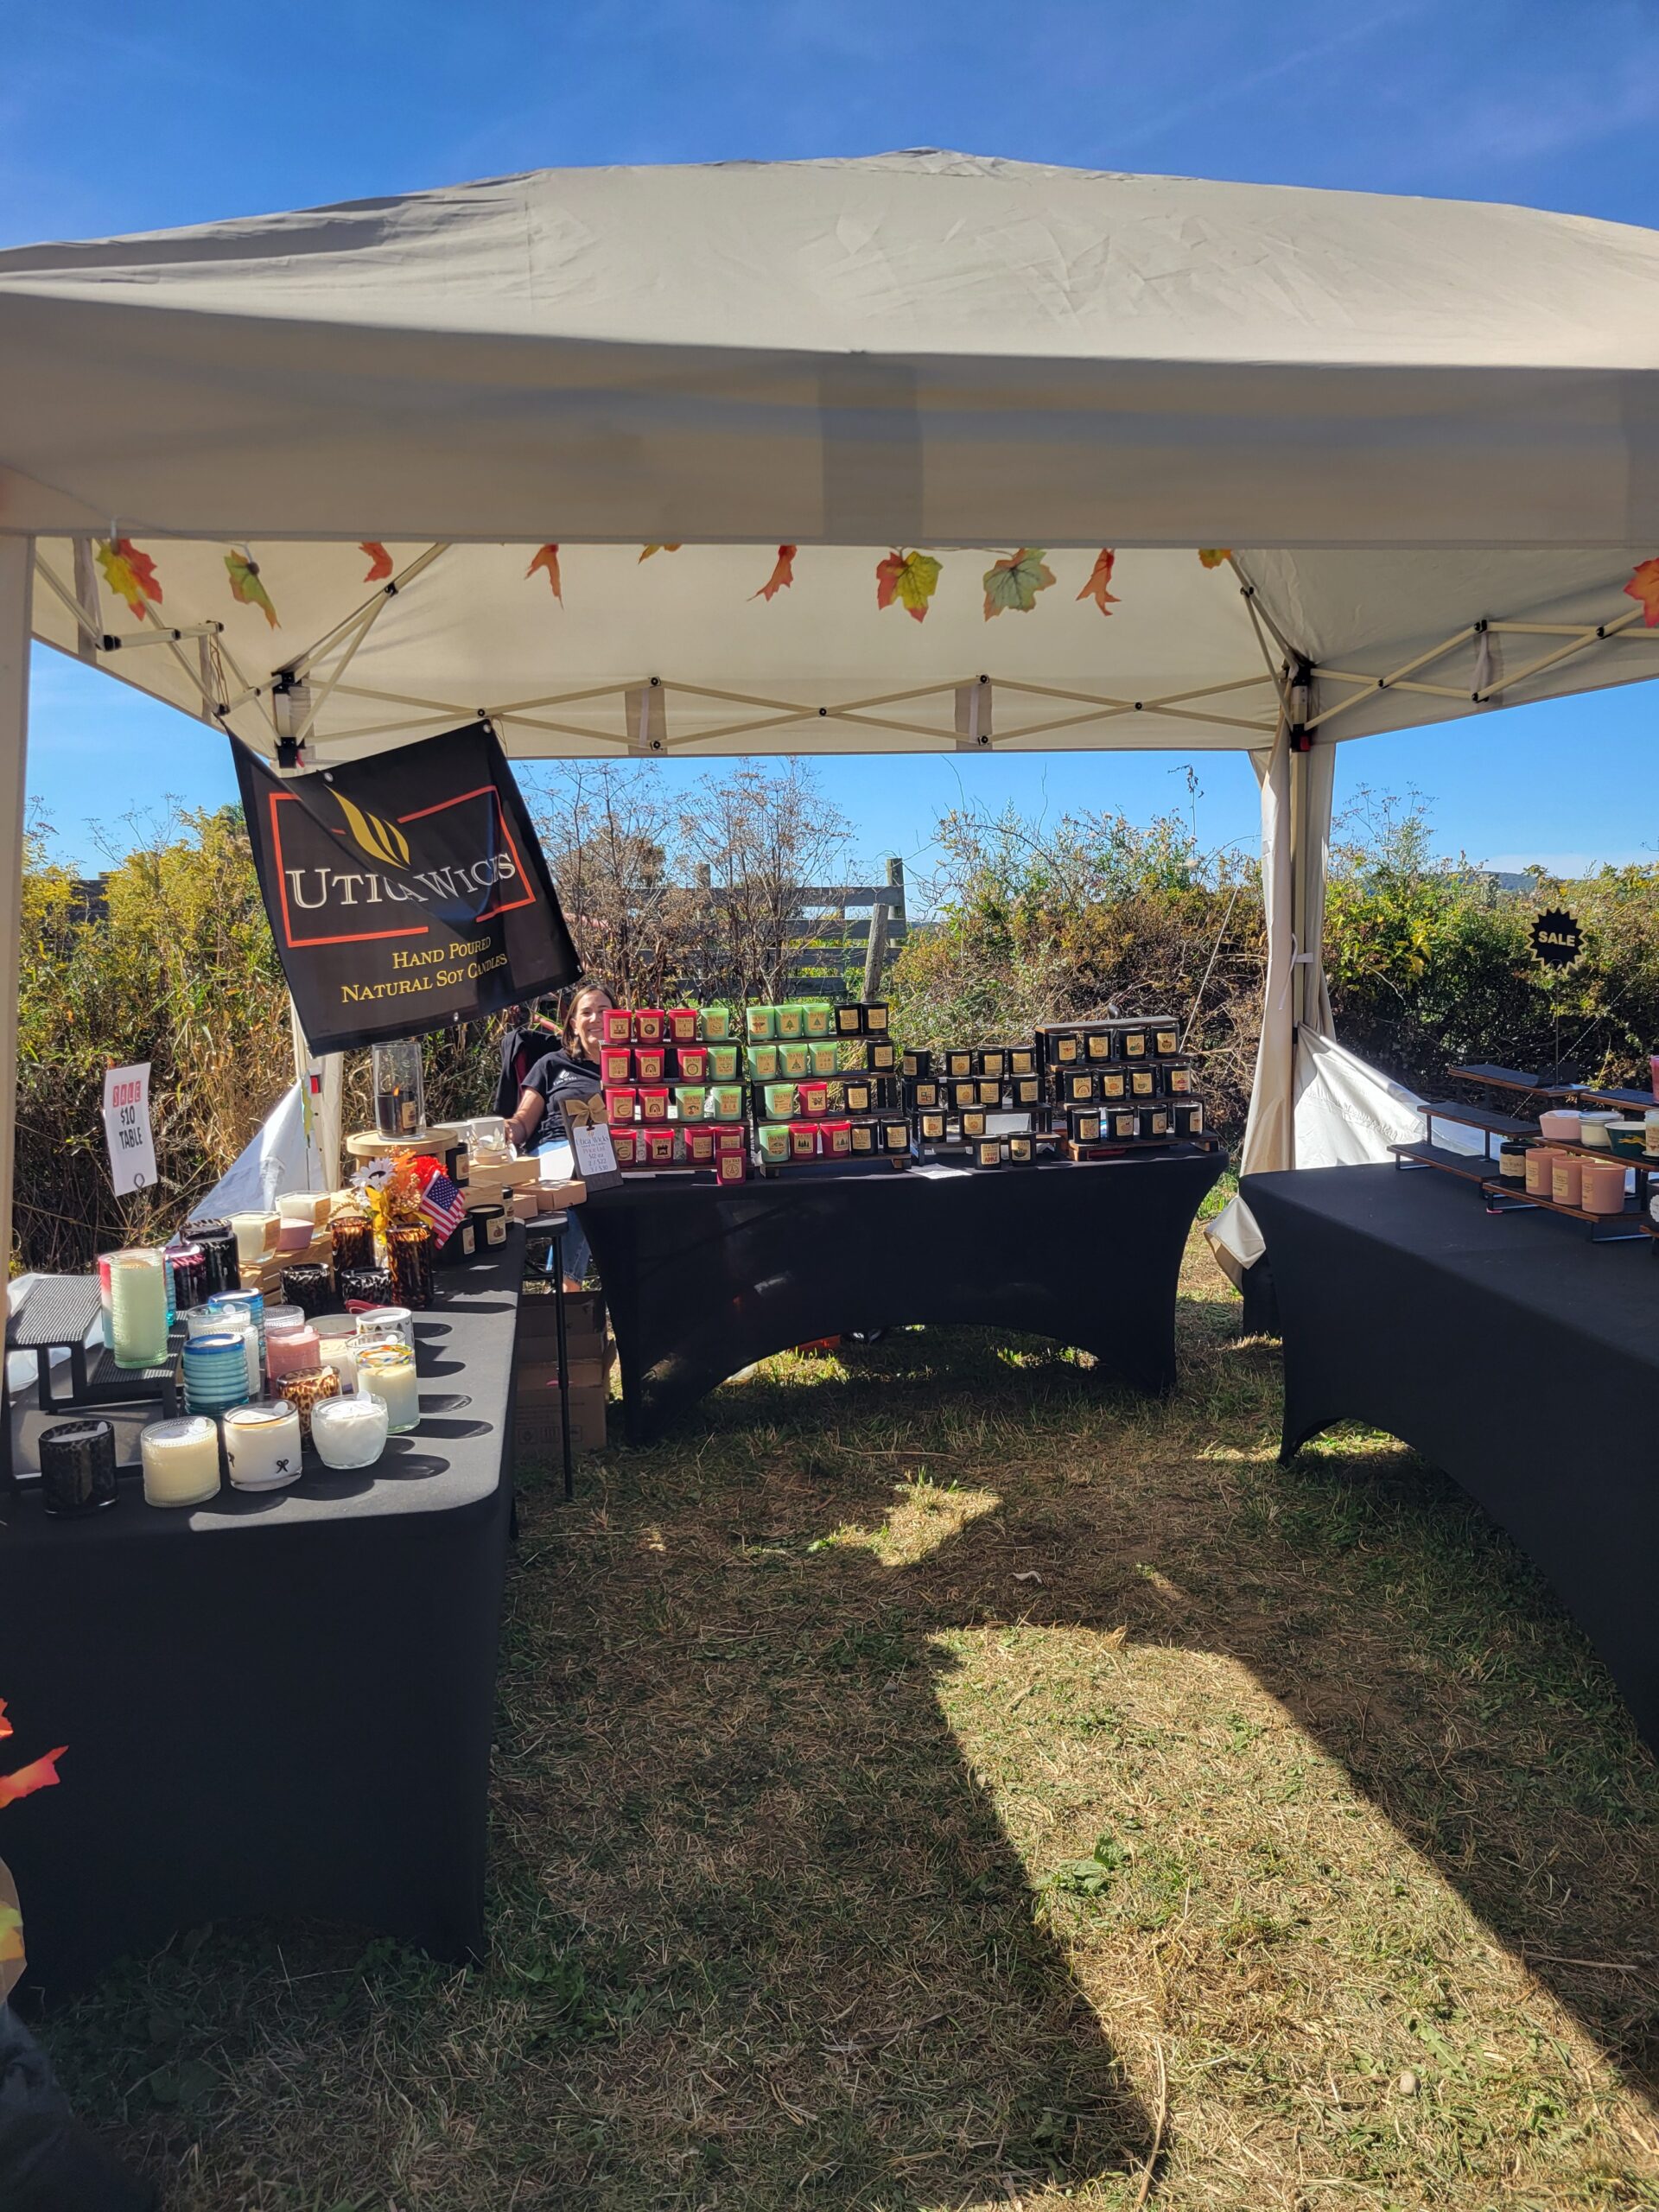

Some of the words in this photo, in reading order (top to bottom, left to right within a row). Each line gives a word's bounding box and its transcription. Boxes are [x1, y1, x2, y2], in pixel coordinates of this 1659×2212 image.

[1537, 931, 1576, 947] SALE
[391, 949, 445, 969] HAND
[448, 936, 492, 960] POURED
[340, 976, 433, 1002] NATURAL
[435, 969, 465, 987] SOY
[467, 953, 508, 979] CANDLES
[113, 1080, 141, 1108] SALE
[120, 1105, 136, 1126] $10
[119, 1127, 143, 1149] TABLE
